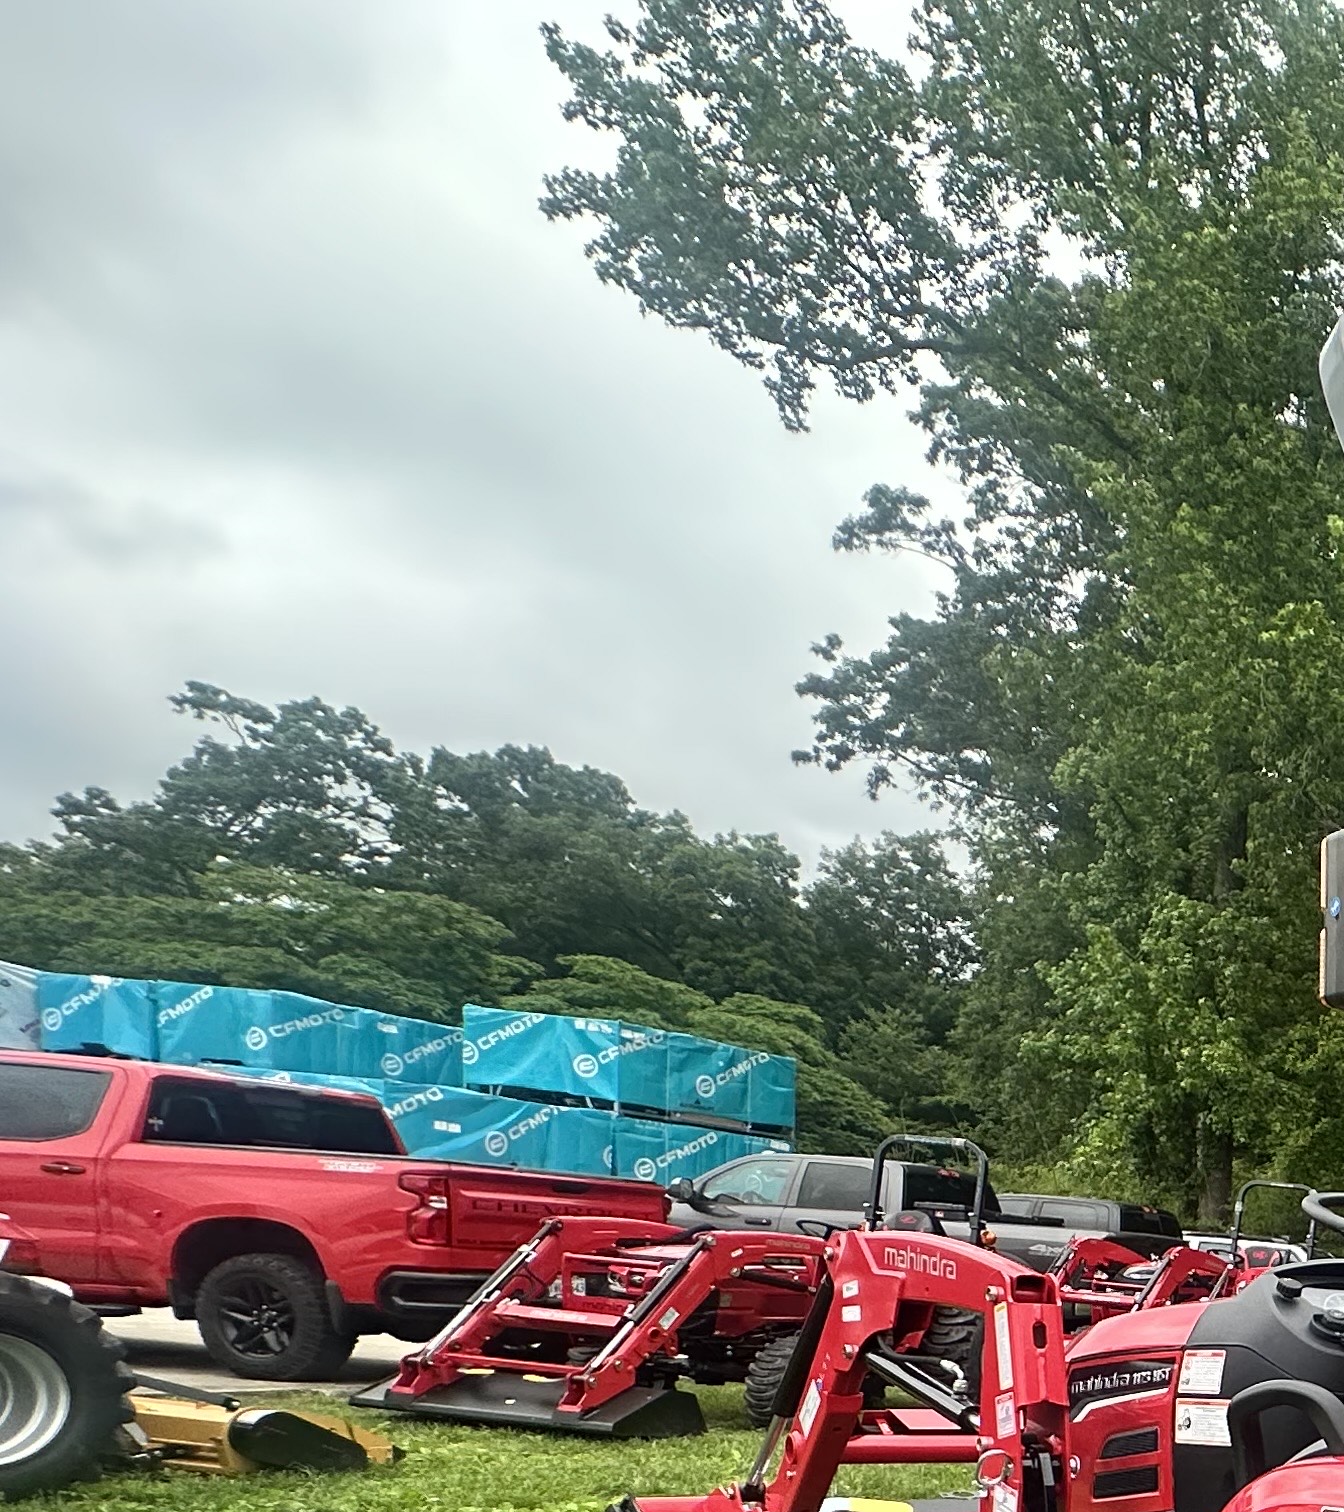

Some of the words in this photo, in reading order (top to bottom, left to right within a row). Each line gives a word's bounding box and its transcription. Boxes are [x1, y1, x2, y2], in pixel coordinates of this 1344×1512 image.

[156, 986, 214, 1028] FMOTO
[268, 1008, 345, 1037] CFMOTO
[403, 1031, 464, 1064] CFMOTO
[477, 1013, 546, 1050] CFMOTO
[598, 1032, 664, 1064] CFMOTO
[715, 1052, 770, 1086] CFMOTO
[655, 1131, 718, 1168] CFMOTO
[884, 1246, 957, 1280] mahindra
